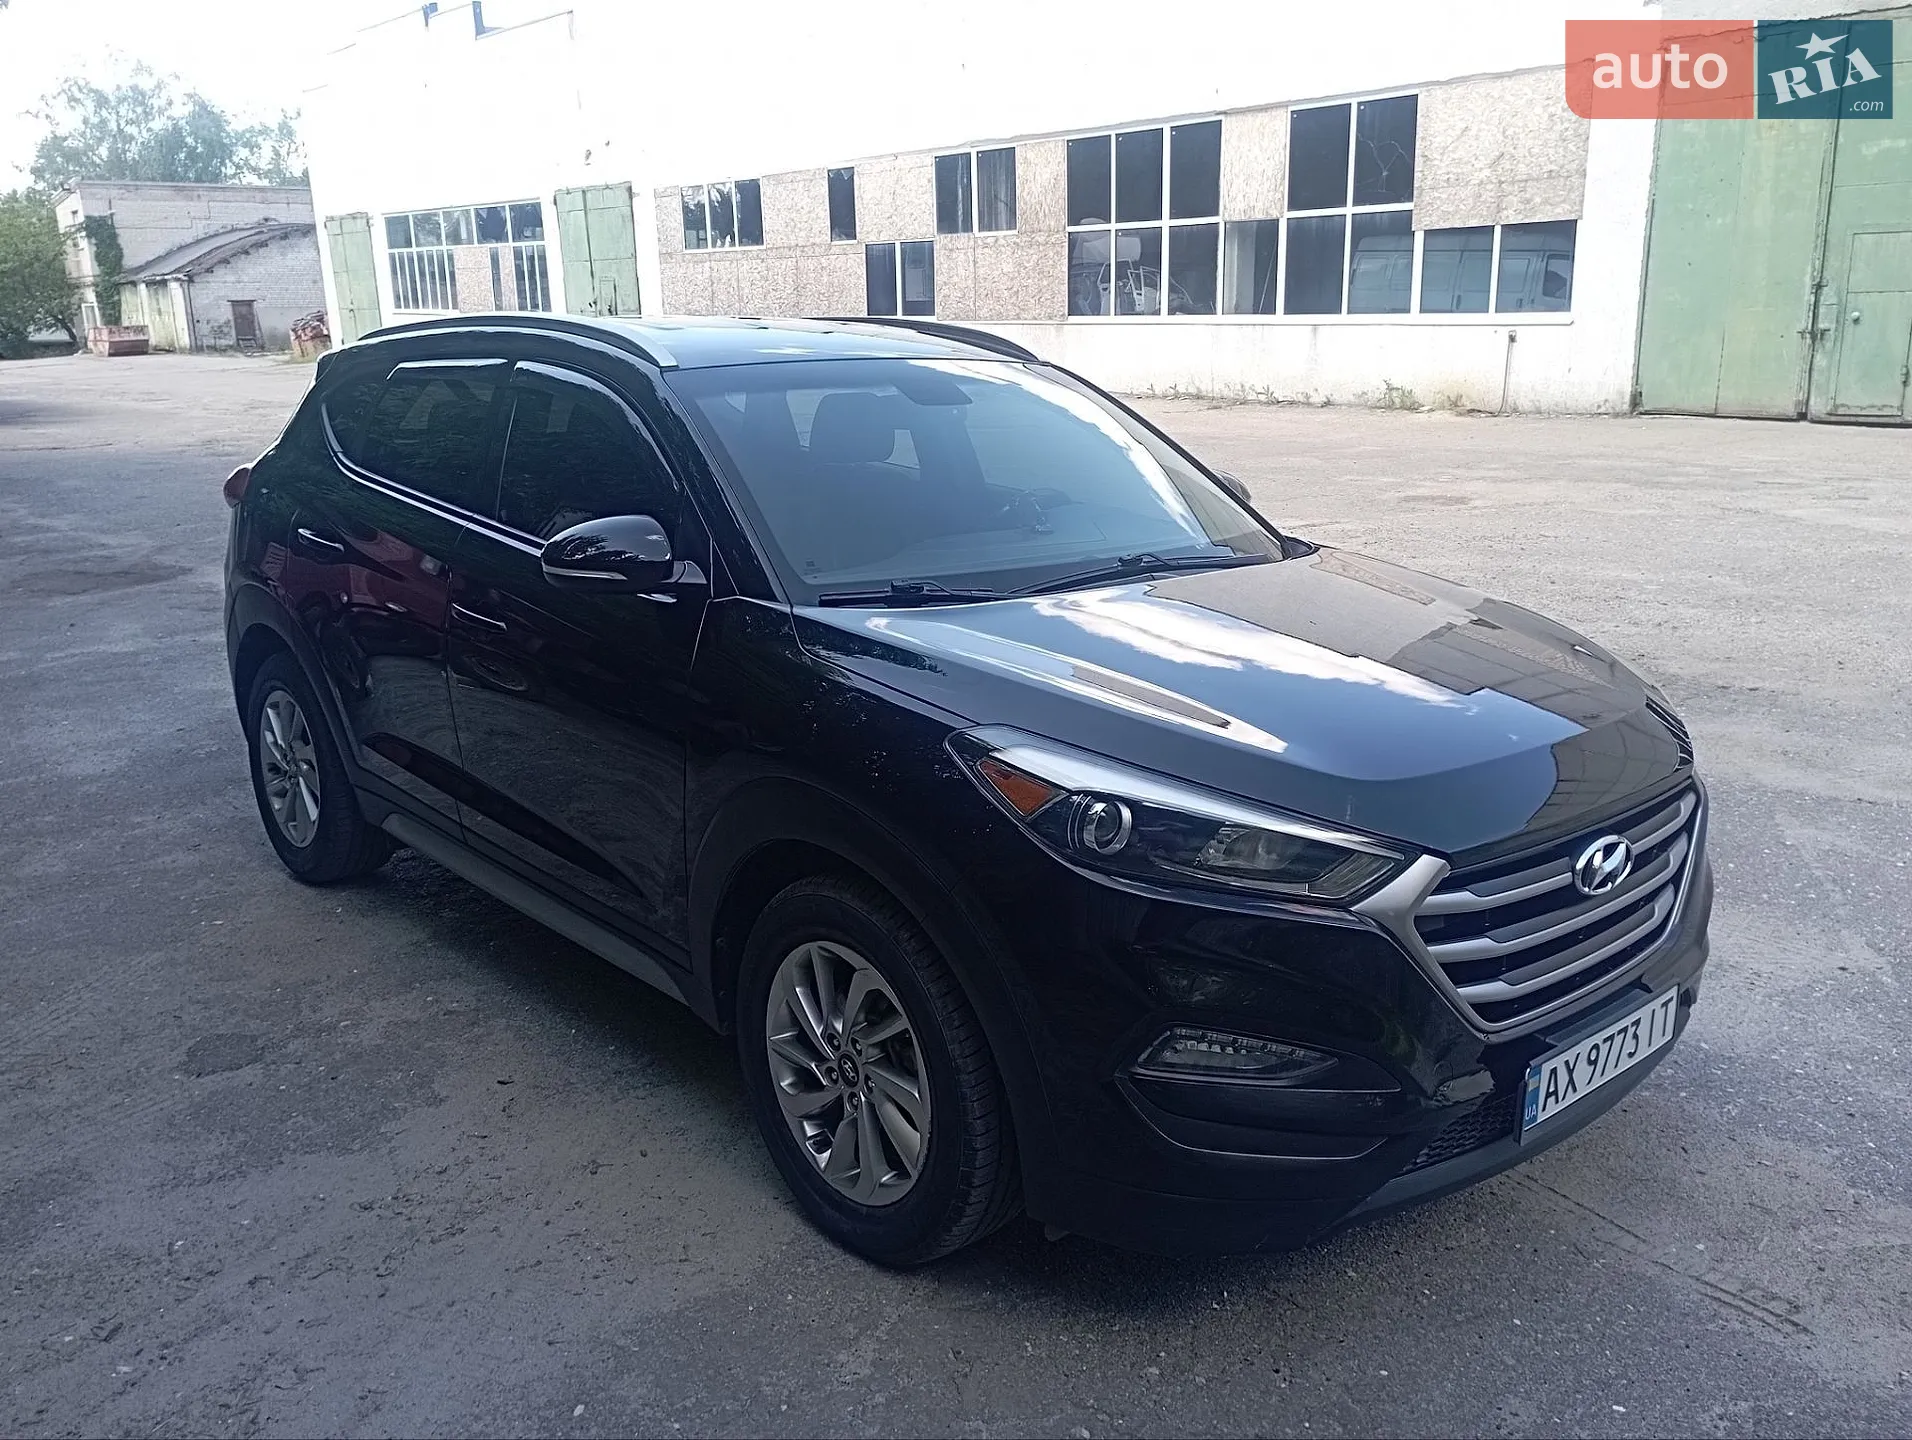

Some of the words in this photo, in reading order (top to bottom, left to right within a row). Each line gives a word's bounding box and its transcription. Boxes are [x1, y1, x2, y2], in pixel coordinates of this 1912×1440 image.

[1541, 1052, 1581, 1113] AX
[1585, 1017, 1642, 1086] 9773
[1648, 996, 1674, 1048] IT
[1525, 1105, 1537, 1120] UA
